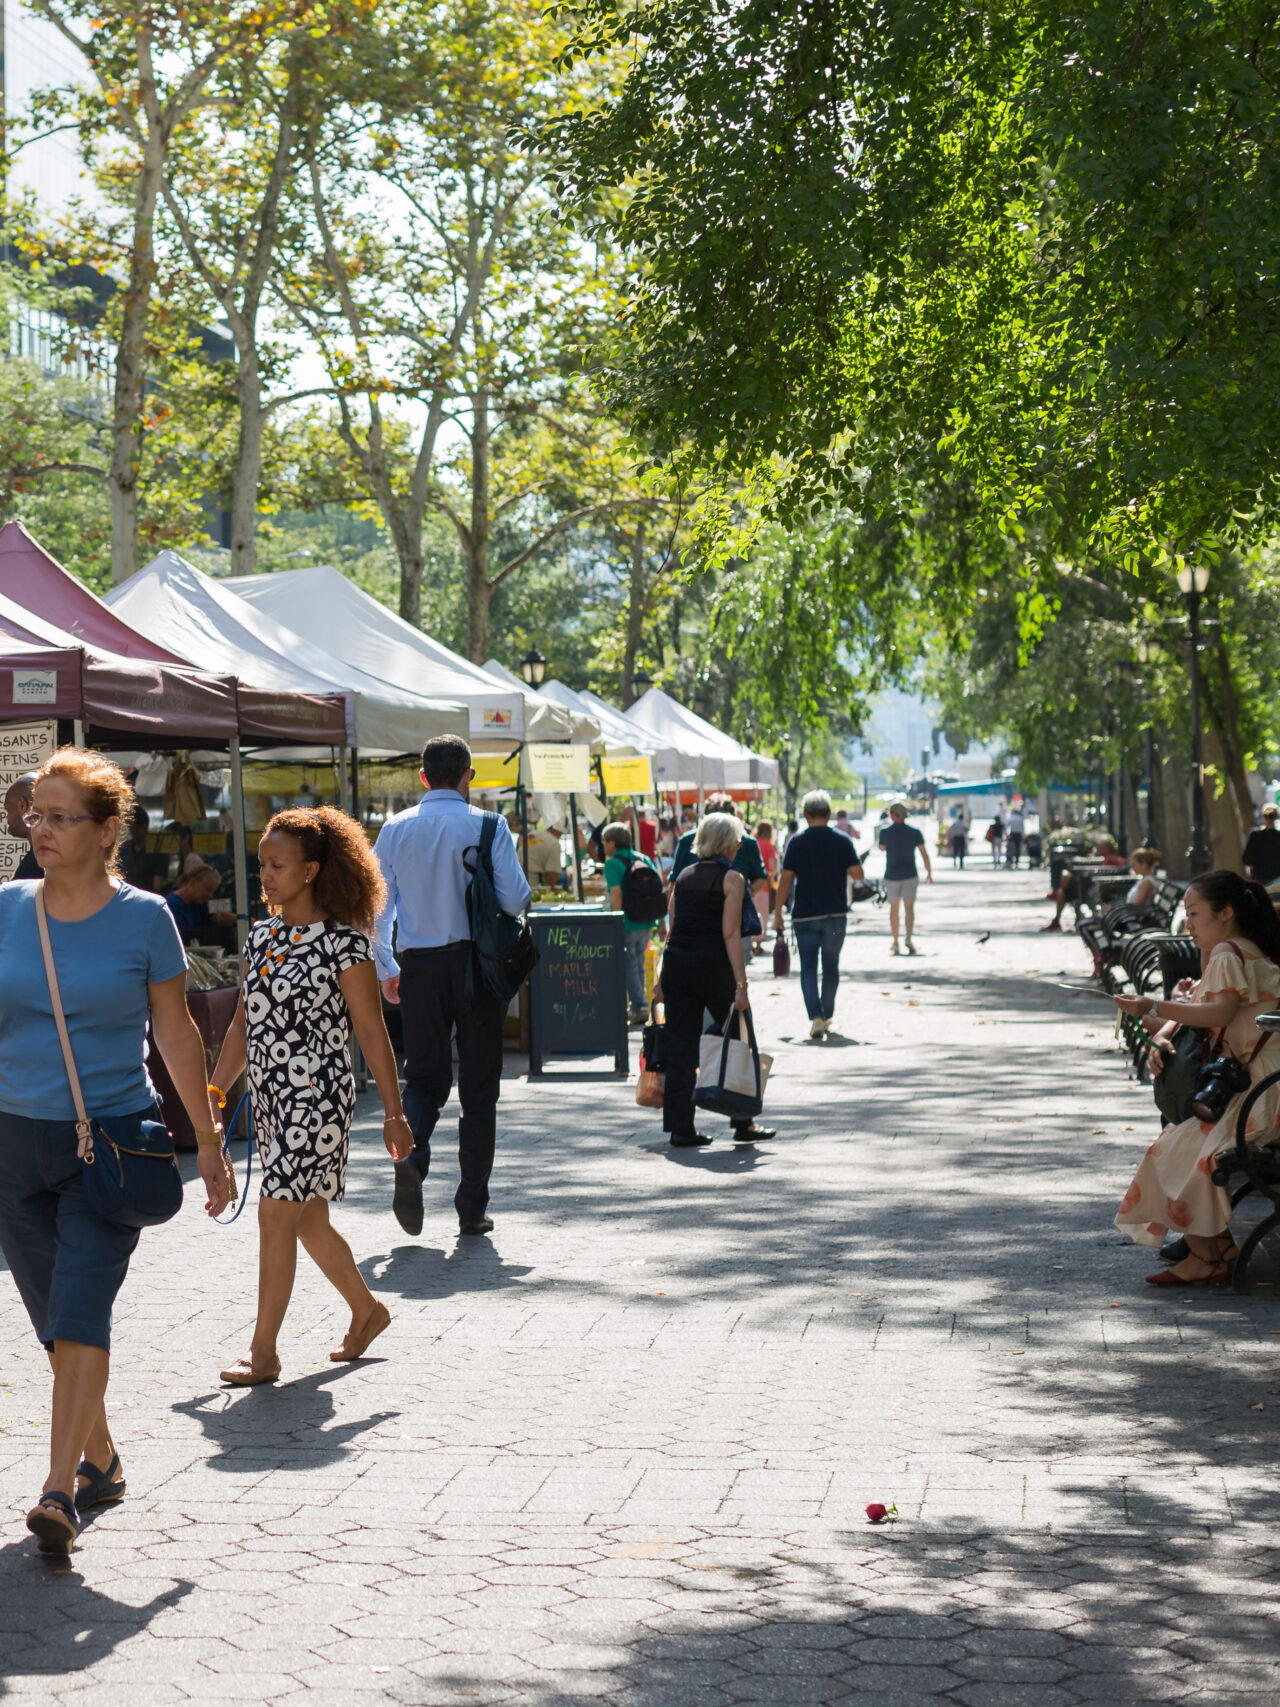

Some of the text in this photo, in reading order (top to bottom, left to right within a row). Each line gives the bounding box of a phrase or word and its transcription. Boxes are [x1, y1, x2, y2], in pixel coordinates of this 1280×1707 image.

[547, 927, 582, 945] NEW
[566, 945, 613, 960] PRODUCT
[549, 962, 592, 978] MAPLE
[564, 978, 598, 996] MILK
